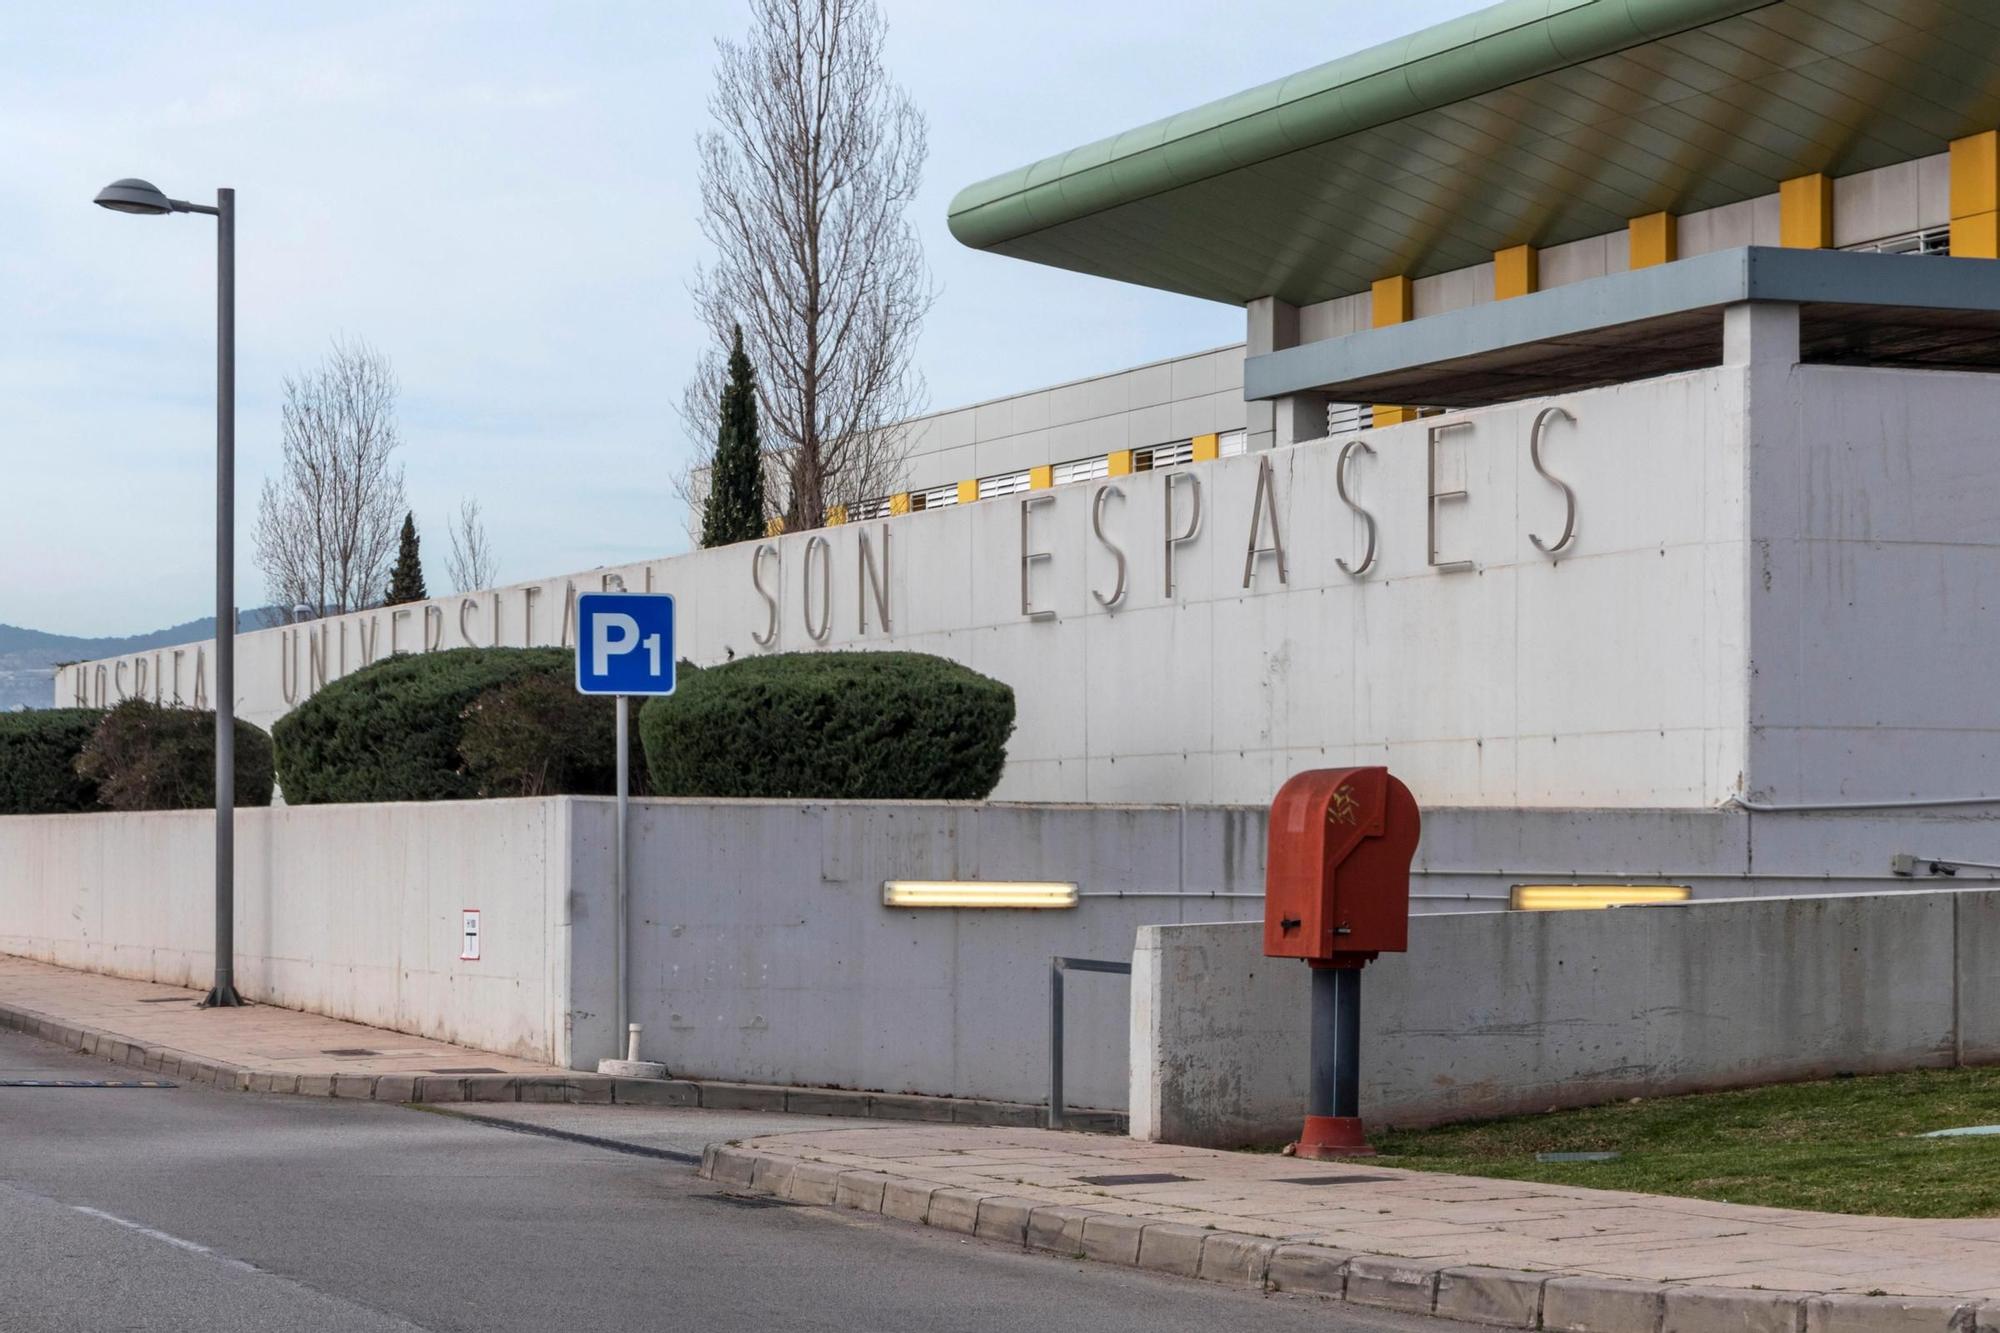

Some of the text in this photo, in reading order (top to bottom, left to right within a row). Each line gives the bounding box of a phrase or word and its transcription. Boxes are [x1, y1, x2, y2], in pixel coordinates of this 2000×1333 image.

[75, 646, 209, 708] HOSPITA
[751, 523, 890, 646] SON
[1021, 407, 1577, 619] ESPASES
[592, 612, 661, 676] P1
